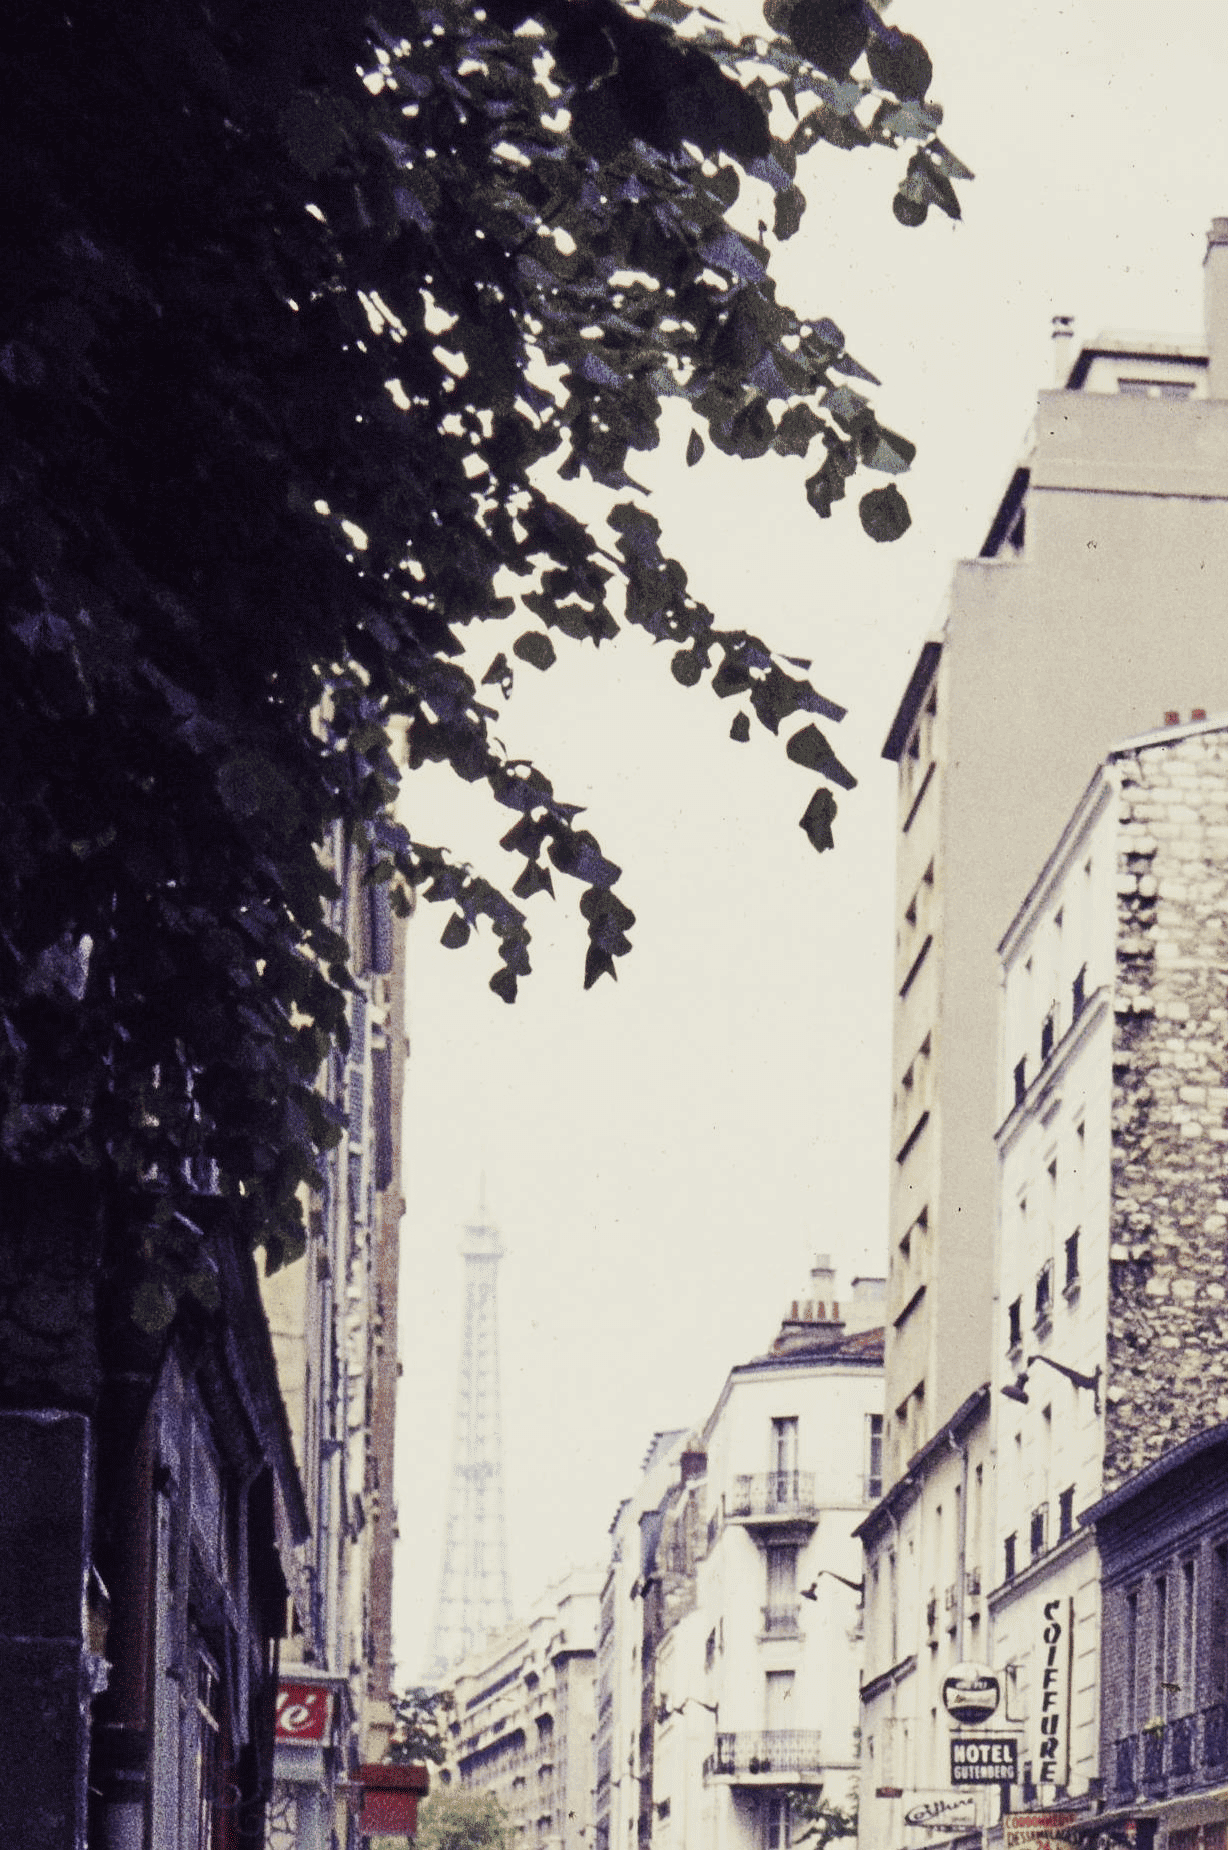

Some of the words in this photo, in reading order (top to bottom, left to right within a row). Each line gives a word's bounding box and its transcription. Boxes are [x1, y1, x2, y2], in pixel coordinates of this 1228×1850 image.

[1040, 1600, 1062, 1784] COIFFURE
[953, 1744, 1014, 1764] HOTEL
[953, 1765, 1015, 1780] GUTENBERG
